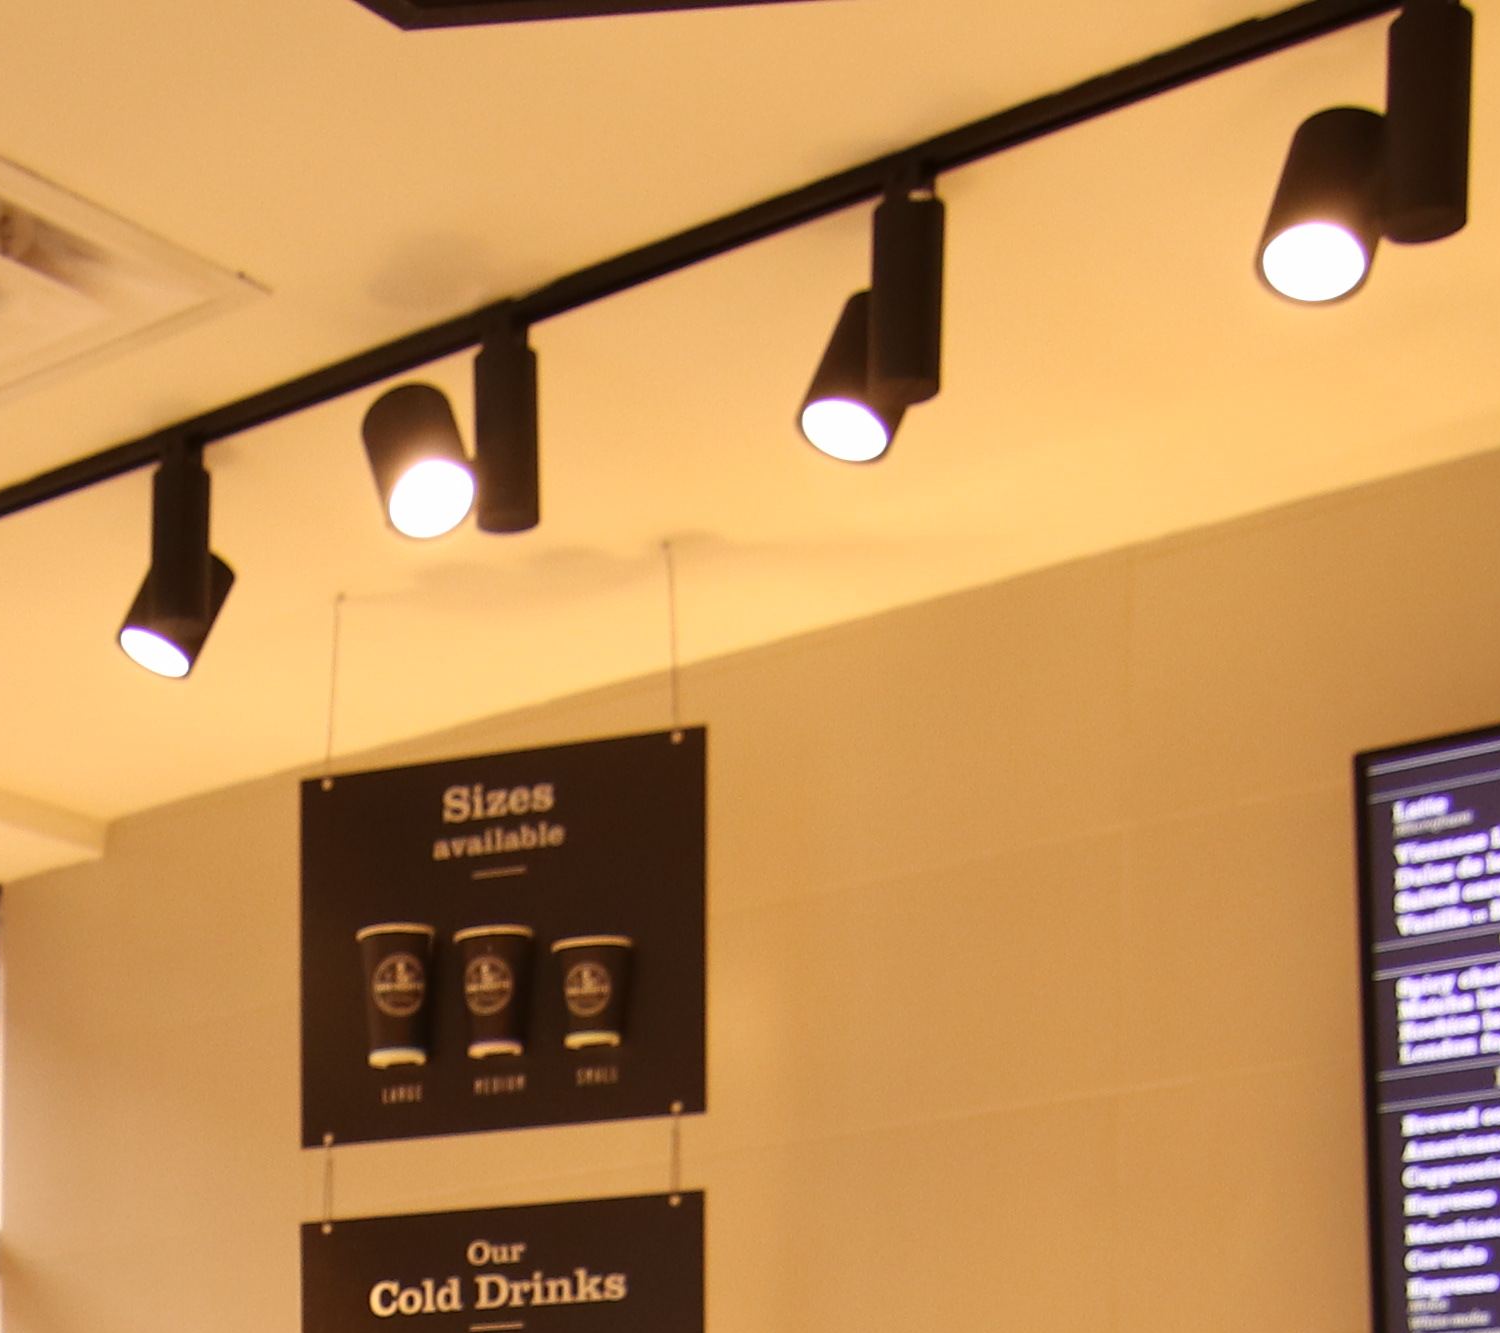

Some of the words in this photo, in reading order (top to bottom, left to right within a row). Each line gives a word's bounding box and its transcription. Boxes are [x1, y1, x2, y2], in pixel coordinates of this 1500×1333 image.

[442, 782, 555, 823] Sizes
[432, 821, 566, 861] available
[466, 1239, 526, 1267] Our
[369, 1277, 462, 1318] Cold
[474, 1267, 627, 1310] Drinks
